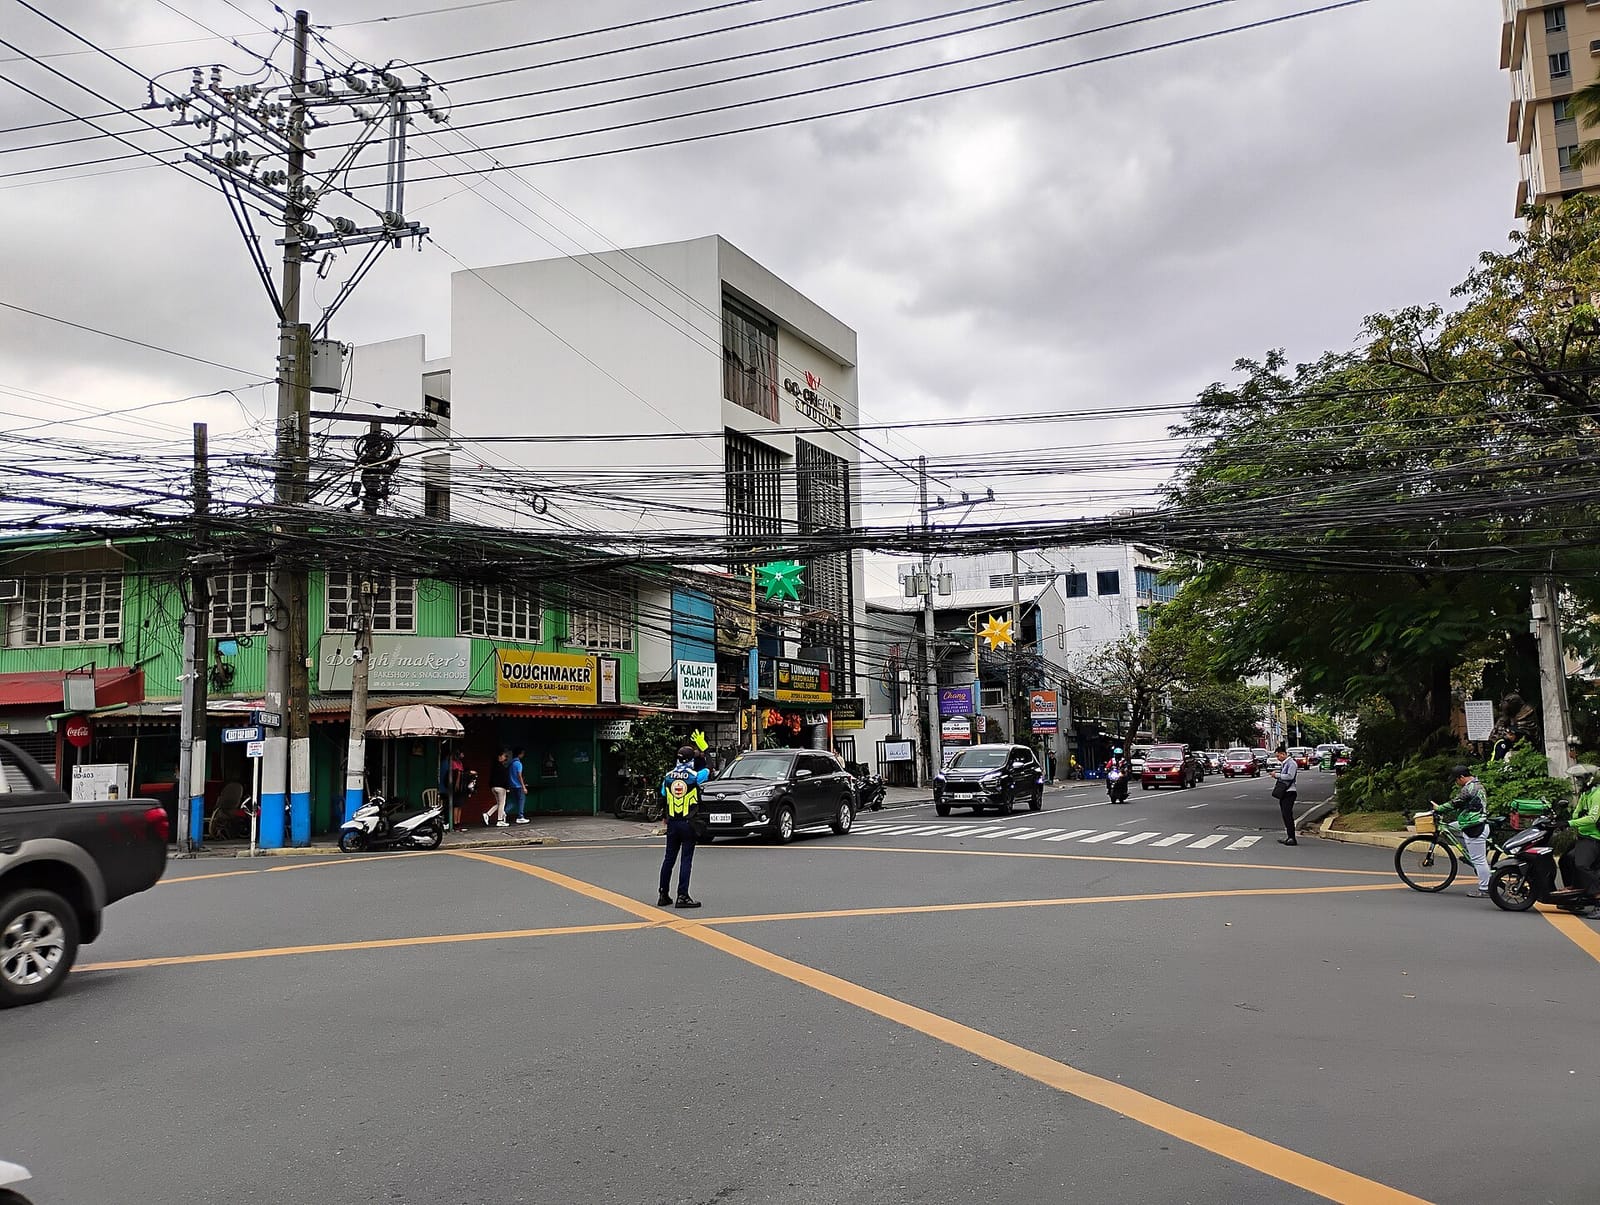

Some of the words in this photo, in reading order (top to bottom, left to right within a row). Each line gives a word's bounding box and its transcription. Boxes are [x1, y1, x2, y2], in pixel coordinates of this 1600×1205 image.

[325, 652, 389, 671] Dogh
[398, 652, 466, 670] maker's
[503, 663, 591, 683] DOUGHMAKER
[680, 663, 715, 677] KALAPIT
[510, 682, 538, 690] BAKESHOP
[543, 683, 569, 691] SARI-SARI
[569, 684, 585, 692] STORE
[683, 677, 711, 689] BAHAY
[681, 689, 713, 701] KAINAN
